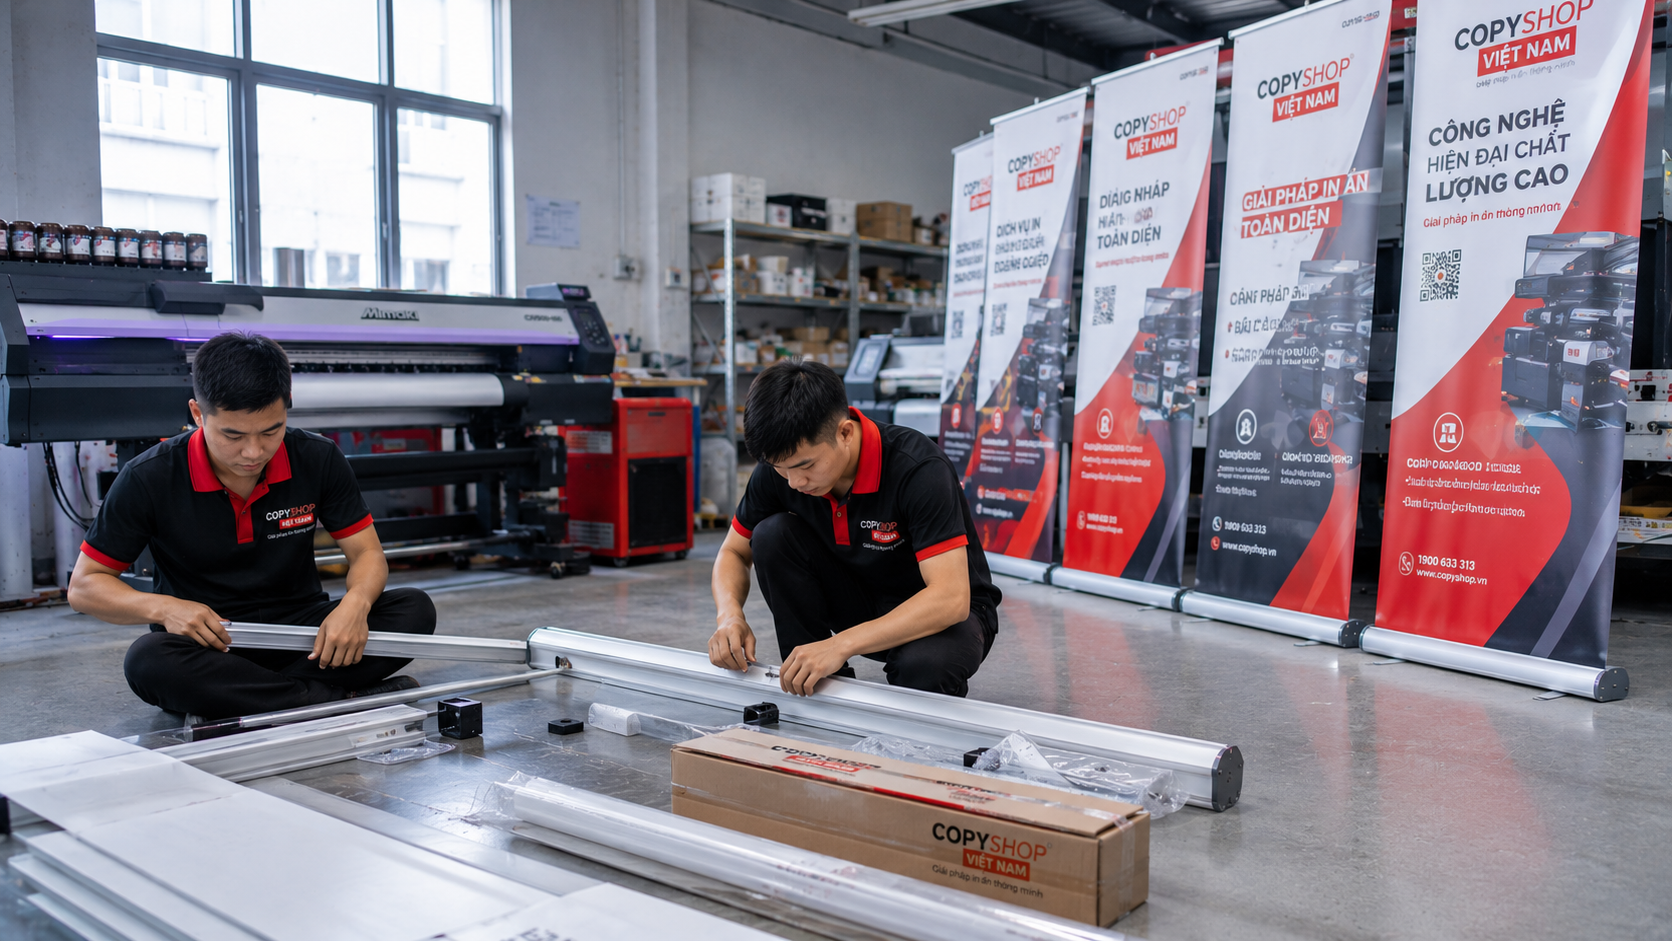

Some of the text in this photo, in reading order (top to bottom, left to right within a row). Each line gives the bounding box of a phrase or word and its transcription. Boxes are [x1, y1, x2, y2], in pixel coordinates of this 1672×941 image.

[1454, 0, 1594, 51] COPYSHOP
[1483, 33, 1570, 72] VIỆT NAM
[1257, 57, 1351, 99] COPYSHOP
[1276, 88, 1335, 120] VIỆT NAM
[1114, 106, 1187, 140] COPYSHOP
[1428, 98, 1566, 147] CÔNG NGHỆ
[1129, 132, 1175, 157] VIỆT NAM
[1427, 129, 1571, 175] HIỆN ĐẠI CHẤT
[1322, 178, 1341, 198] IN
[1425, 163, 1569, 203] LƯỢNG CAO
[1416, 568, 1488, 585] www.copyshop.vn
[1417, 554, 1476, 571] 1900 633 313
[932, 822, 1047, 862] COPYSHOP
[966, 852, 1026, 878] VIỆT NAM
